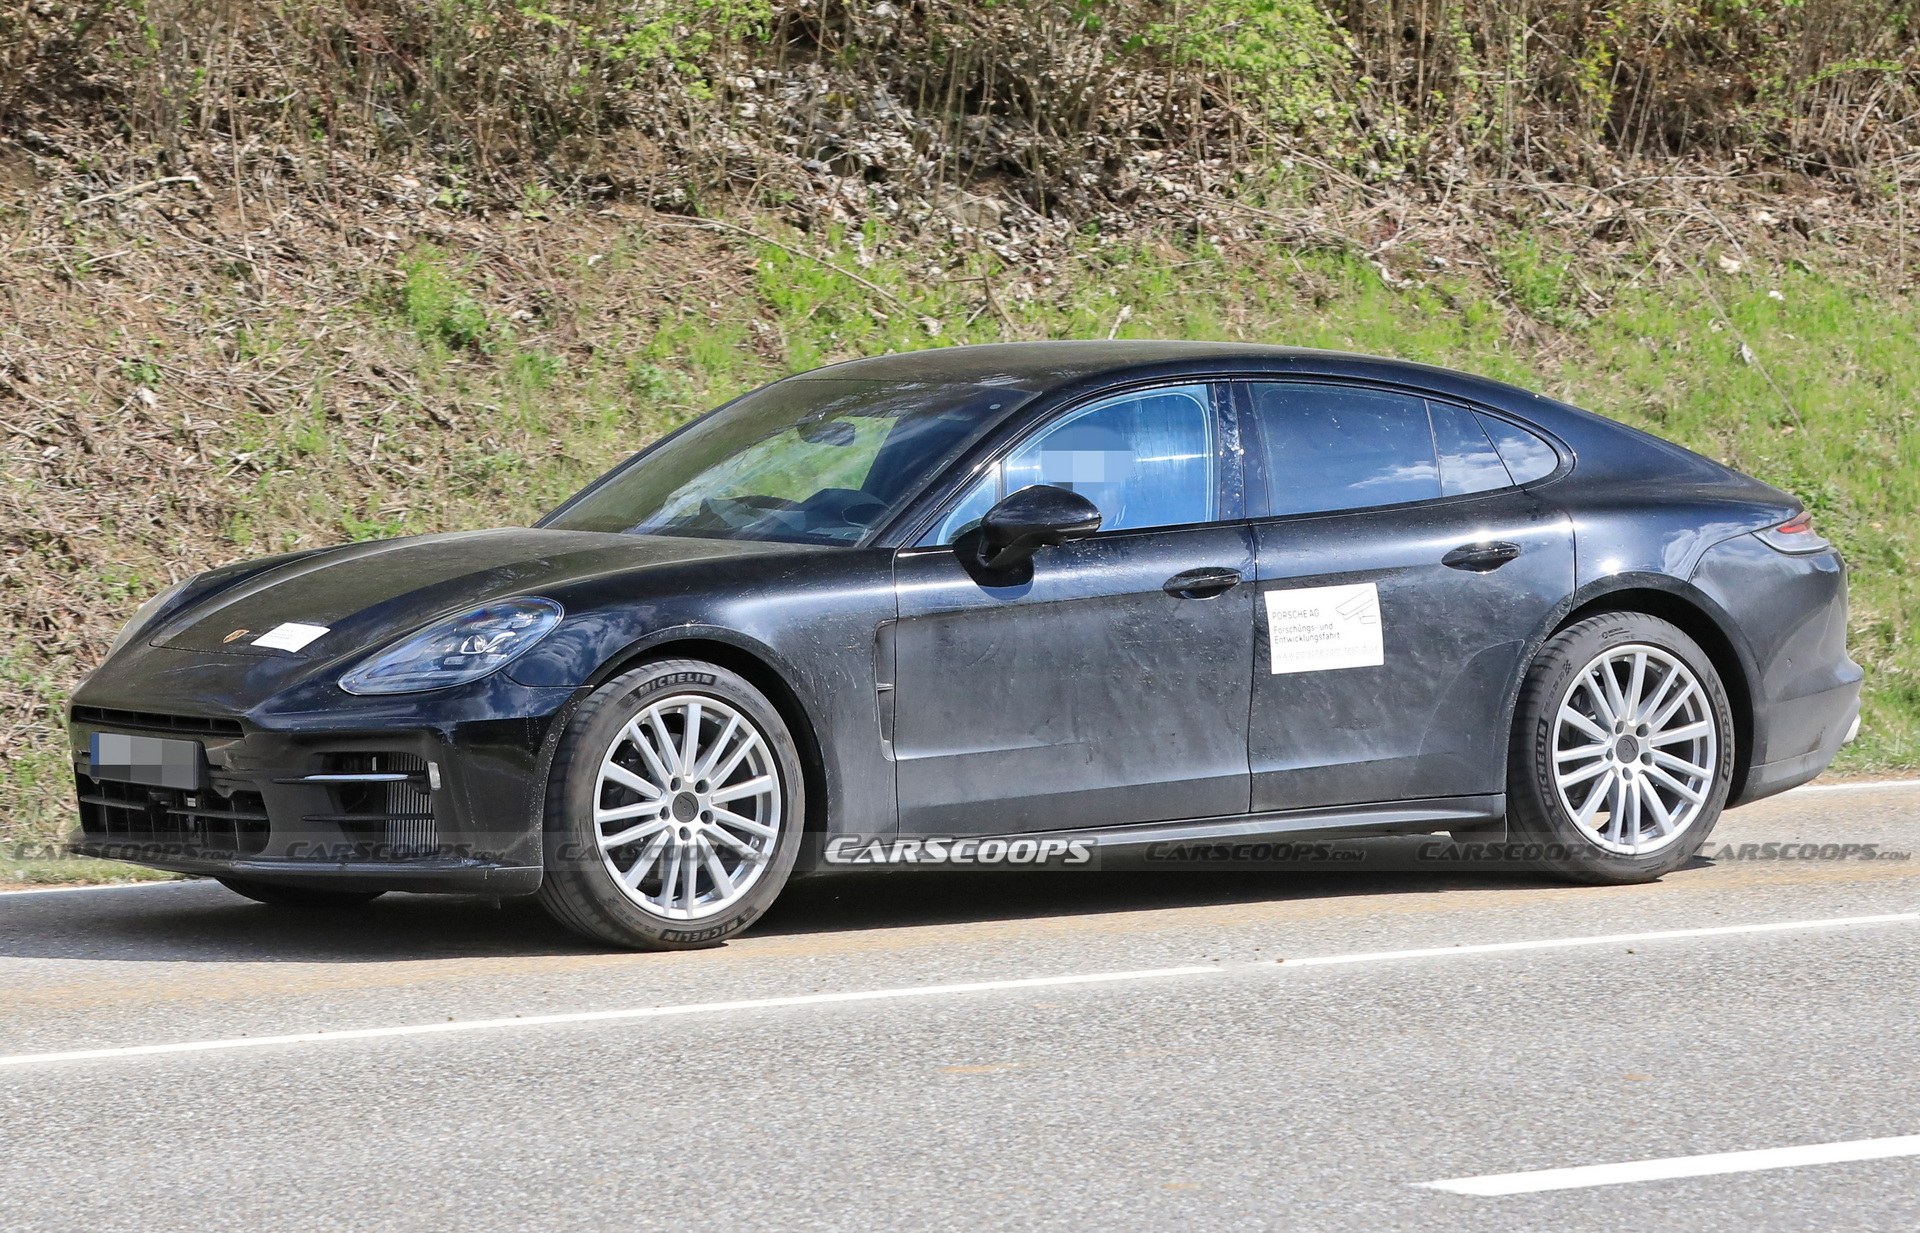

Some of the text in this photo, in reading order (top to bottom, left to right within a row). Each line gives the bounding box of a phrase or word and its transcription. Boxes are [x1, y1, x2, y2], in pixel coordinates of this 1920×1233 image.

[1271, 608, 1320, 621] PORSCHE AG
[1274, 631, 1341, 645] Entwicklungsfahrt
[1319, 622, 1334, 631] und
[638, 673, 714, 697] MICHELIN
[1715, 692, 1732, 778] MICHELIN
[1536, 717, 1554, 807] MICHELIN
[663, 918, 740, 941] MICHELIN
